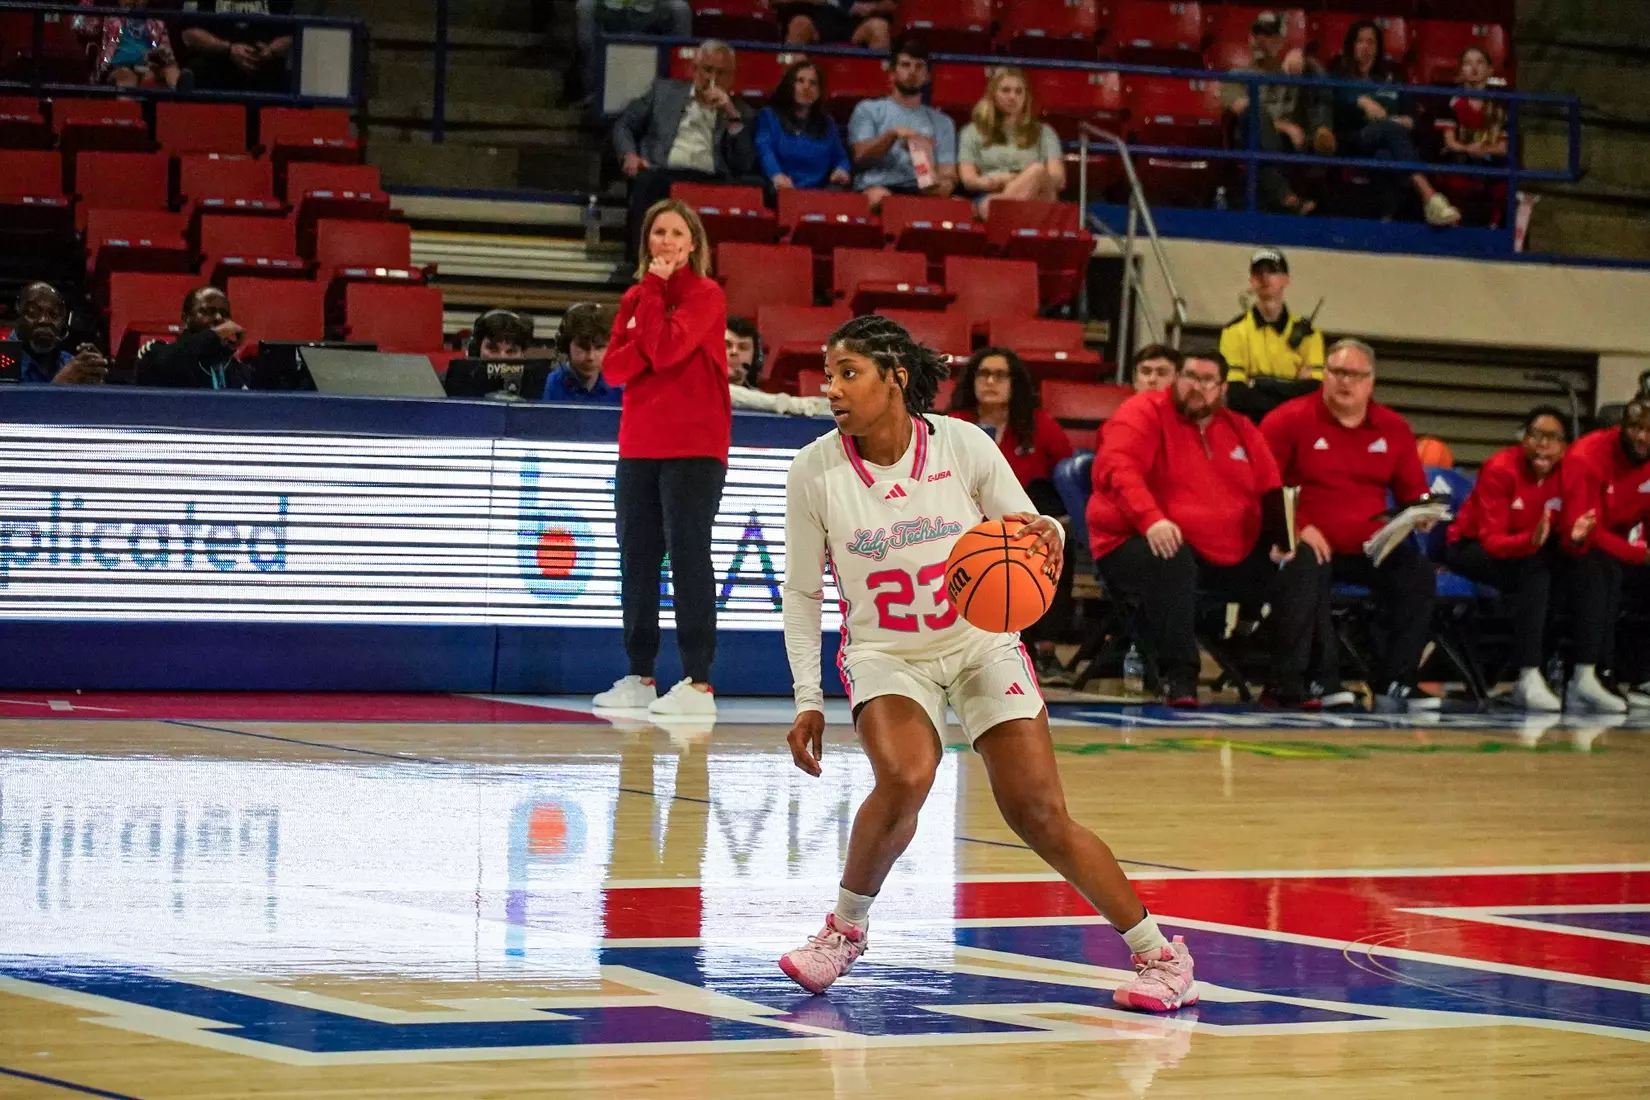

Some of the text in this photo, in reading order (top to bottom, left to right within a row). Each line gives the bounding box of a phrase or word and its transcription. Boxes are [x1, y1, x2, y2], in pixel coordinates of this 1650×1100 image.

[927, 470, 952, 482] C-USA
[846, 516, 962, 561] Lady Techsters
[866, 560, 959, 633] 23
